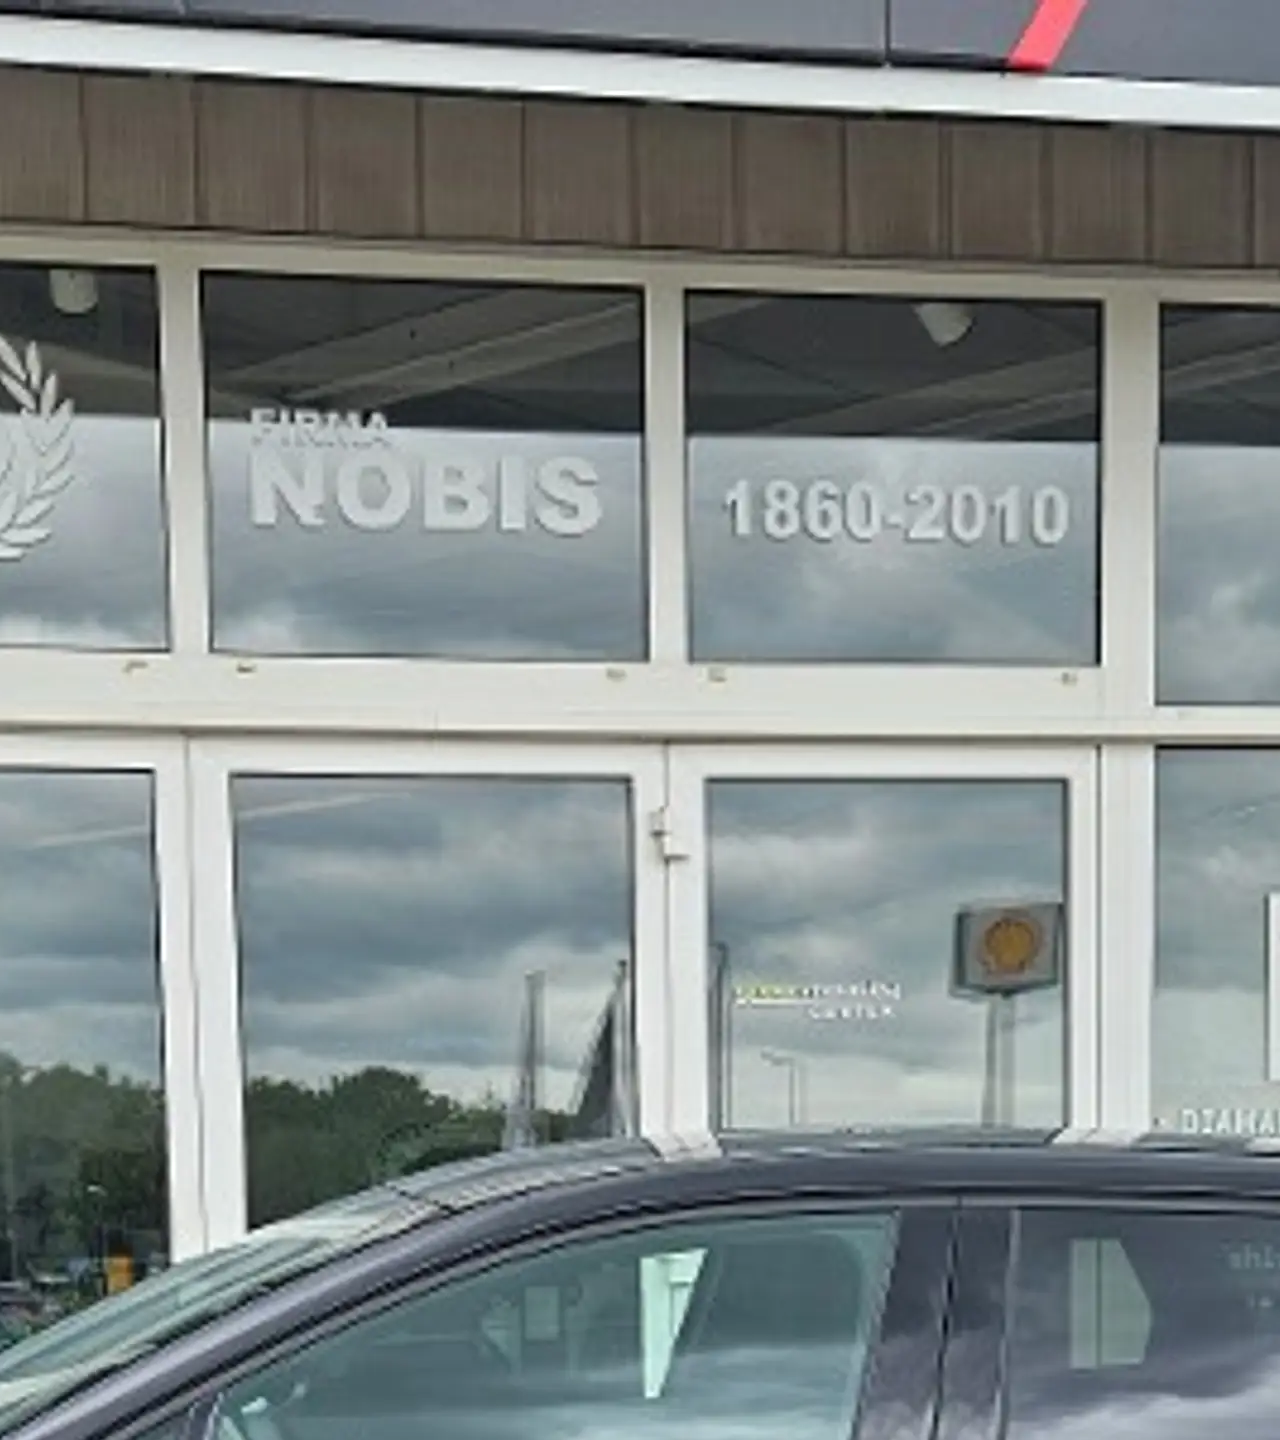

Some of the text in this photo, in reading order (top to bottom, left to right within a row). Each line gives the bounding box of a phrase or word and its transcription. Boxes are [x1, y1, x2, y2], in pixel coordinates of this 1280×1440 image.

[250, 407, 392, 447] FIRMA
[250, 448, 603, 537] NOBIS
[723, 479, 1069, 543] 1860-2010
